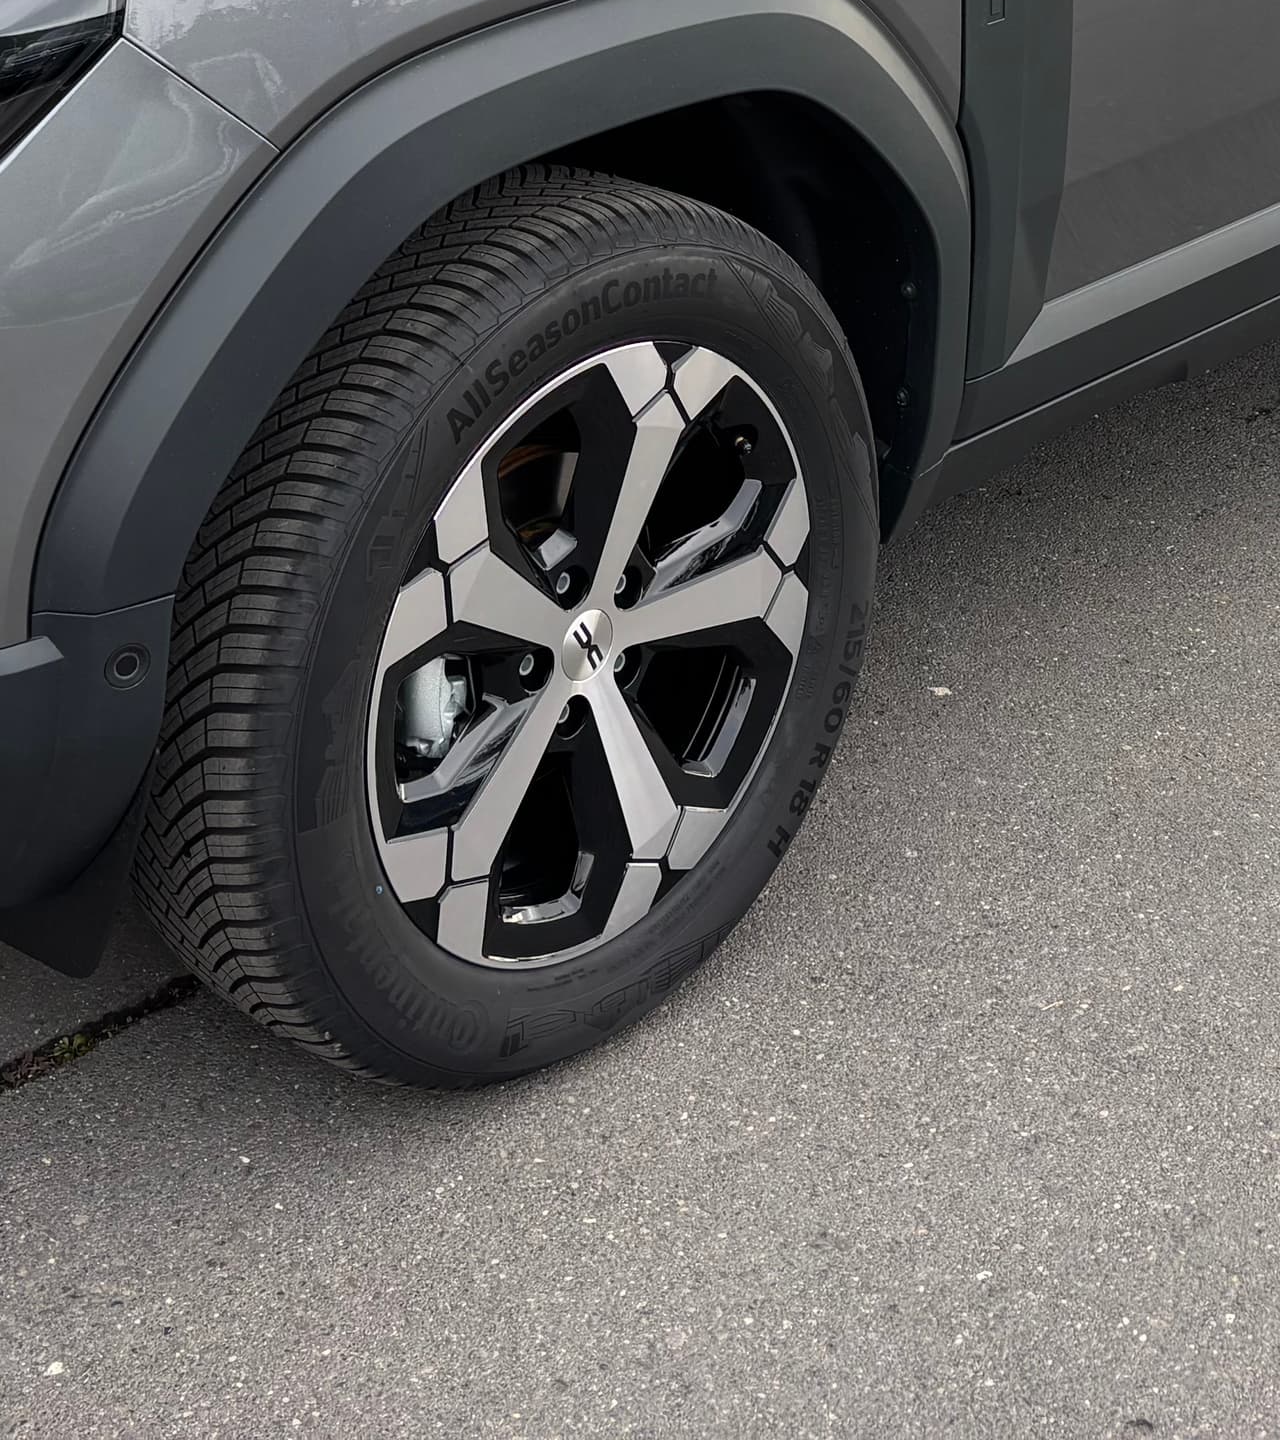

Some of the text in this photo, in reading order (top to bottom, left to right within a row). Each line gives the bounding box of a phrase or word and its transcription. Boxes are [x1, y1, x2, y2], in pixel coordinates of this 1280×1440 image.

[444, 268, 719, 437] AllSeasonContact
[823, 601, 868, 735] 215/60
[787, 774, 817, 820] 18
